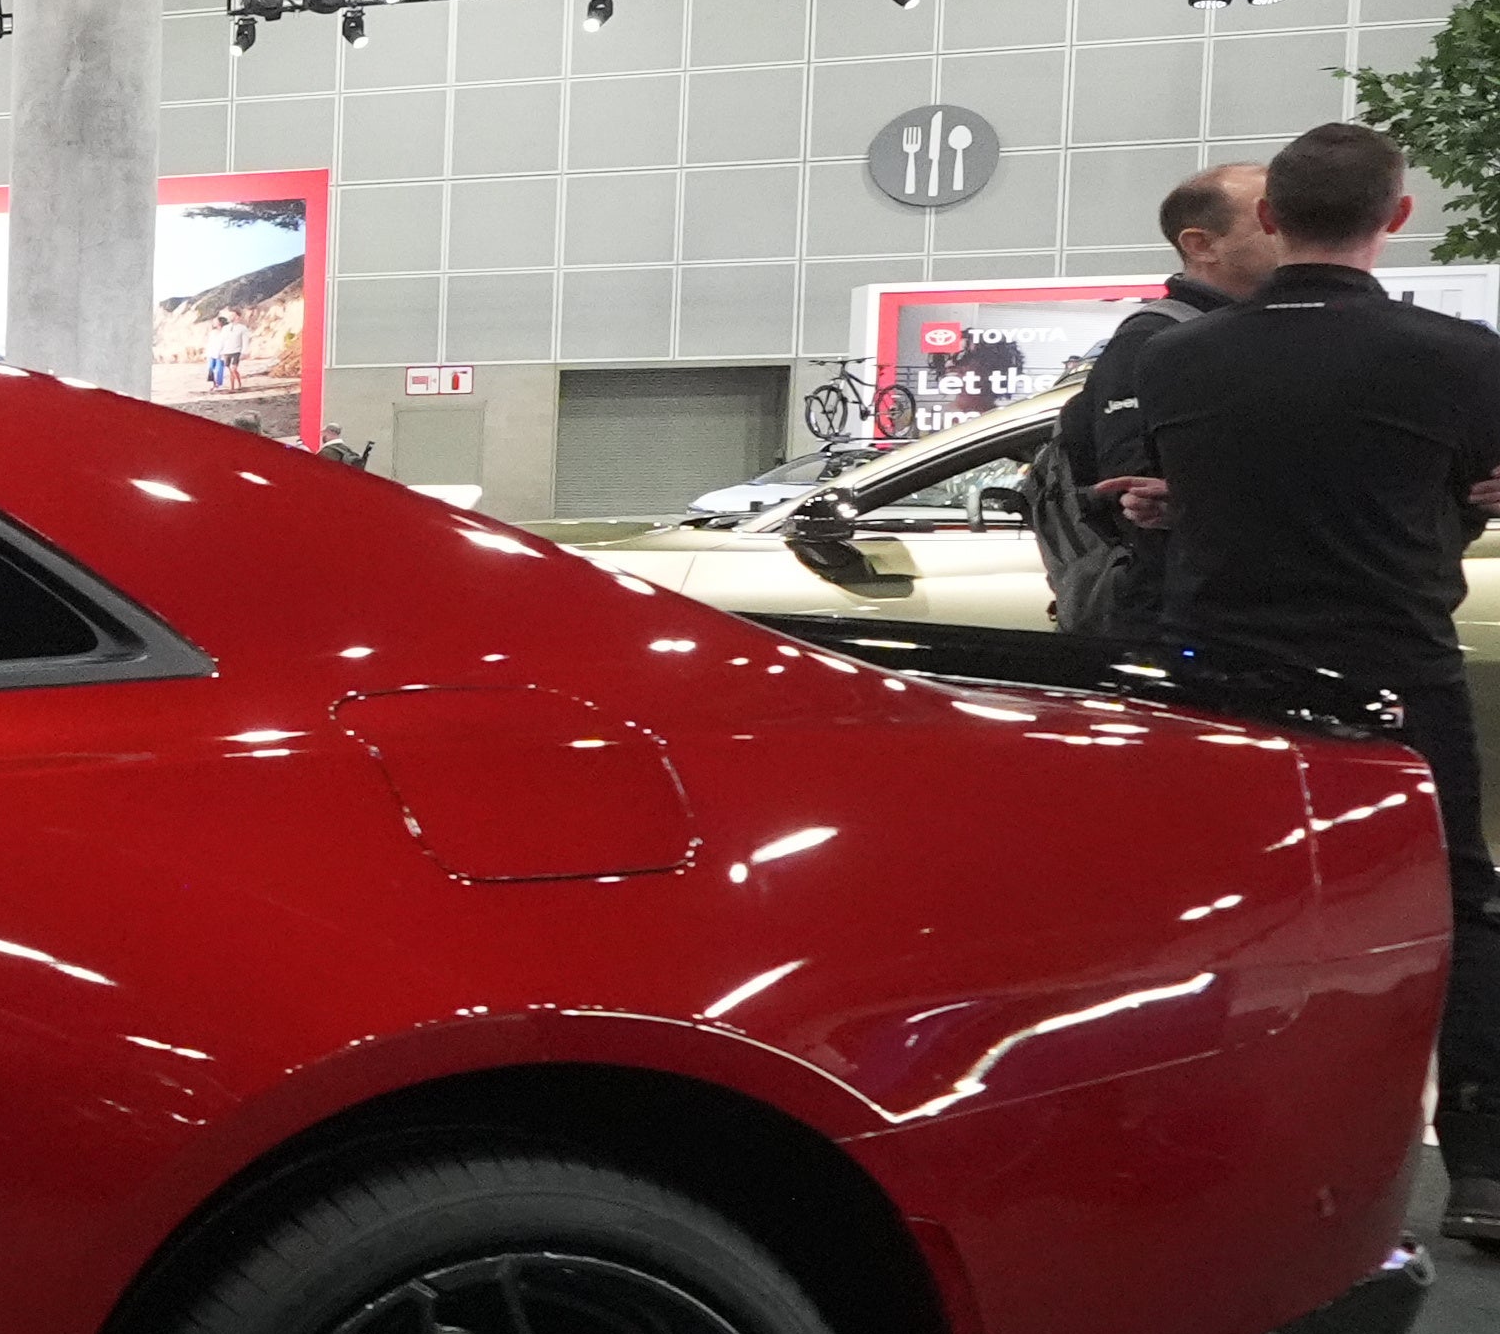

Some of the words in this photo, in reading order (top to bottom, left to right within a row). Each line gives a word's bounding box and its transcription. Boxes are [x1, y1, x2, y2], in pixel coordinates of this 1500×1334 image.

[968, 327, 1068, 344] TOYOTA
[917, 370, 981, 395] Let
[988, 367, 1057, 394] the
[916, 404, 982, 431] tim
